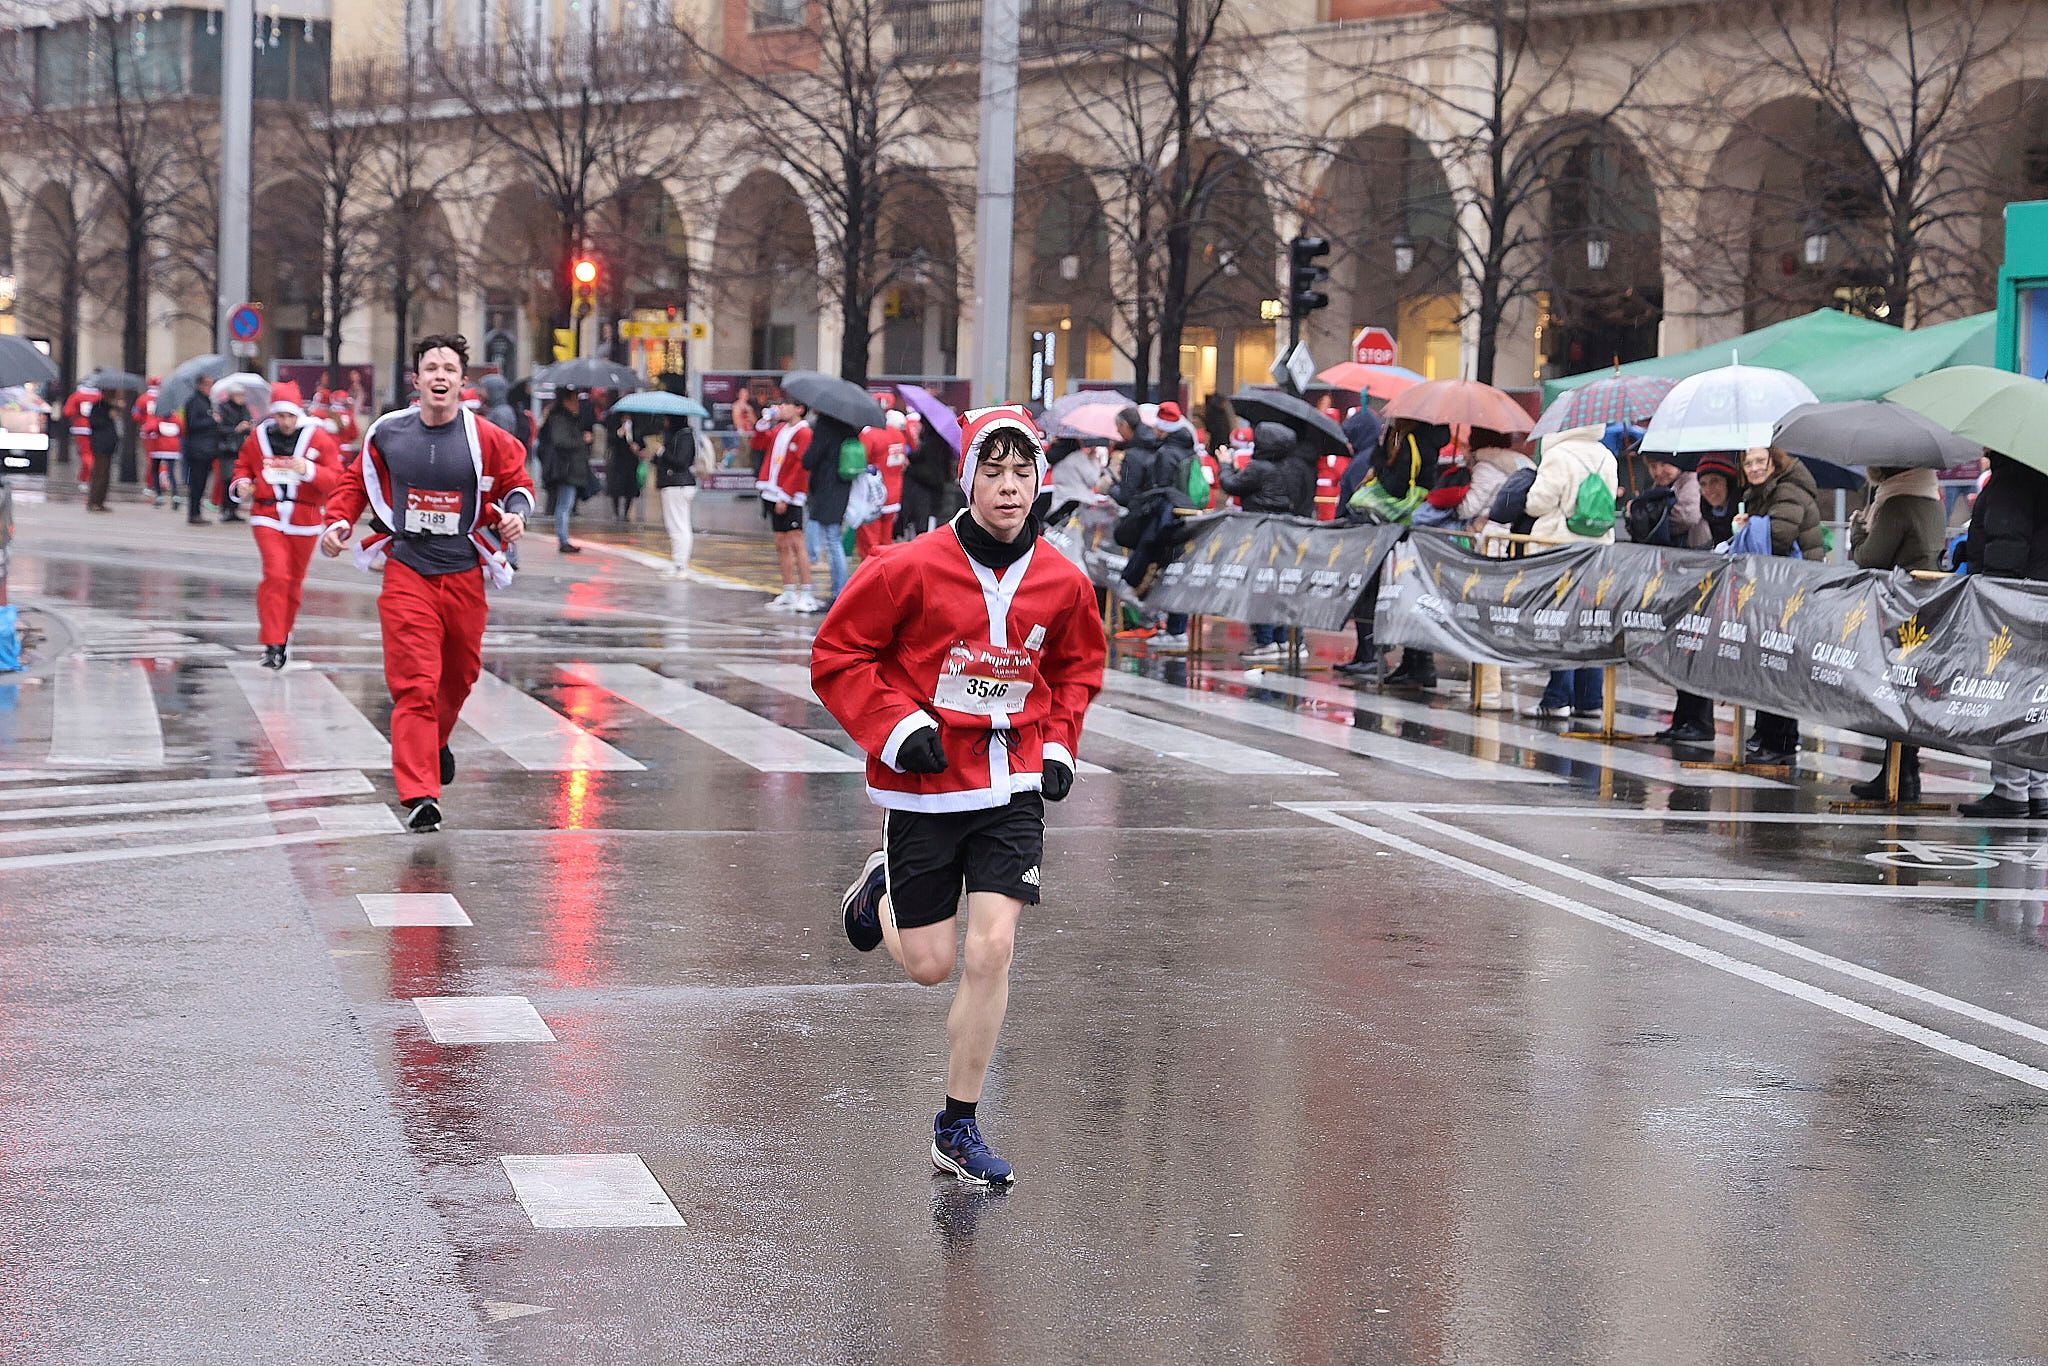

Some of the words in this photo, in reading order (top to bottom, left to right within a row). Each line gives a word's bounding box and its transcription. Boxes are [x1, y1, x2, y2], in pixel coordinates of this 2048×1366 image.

[1359, 348, 1392, 362] STOP
[420, 512, 445, 524] 2189
[966, 678, 1009, 698] 3546
[1949, 675, 1980, 698] CAJA
[1974, 679, 2011, 700] RURAL
[1946, 700, 1962, 715] DE
[2025, 707, 2040, 723] DE
